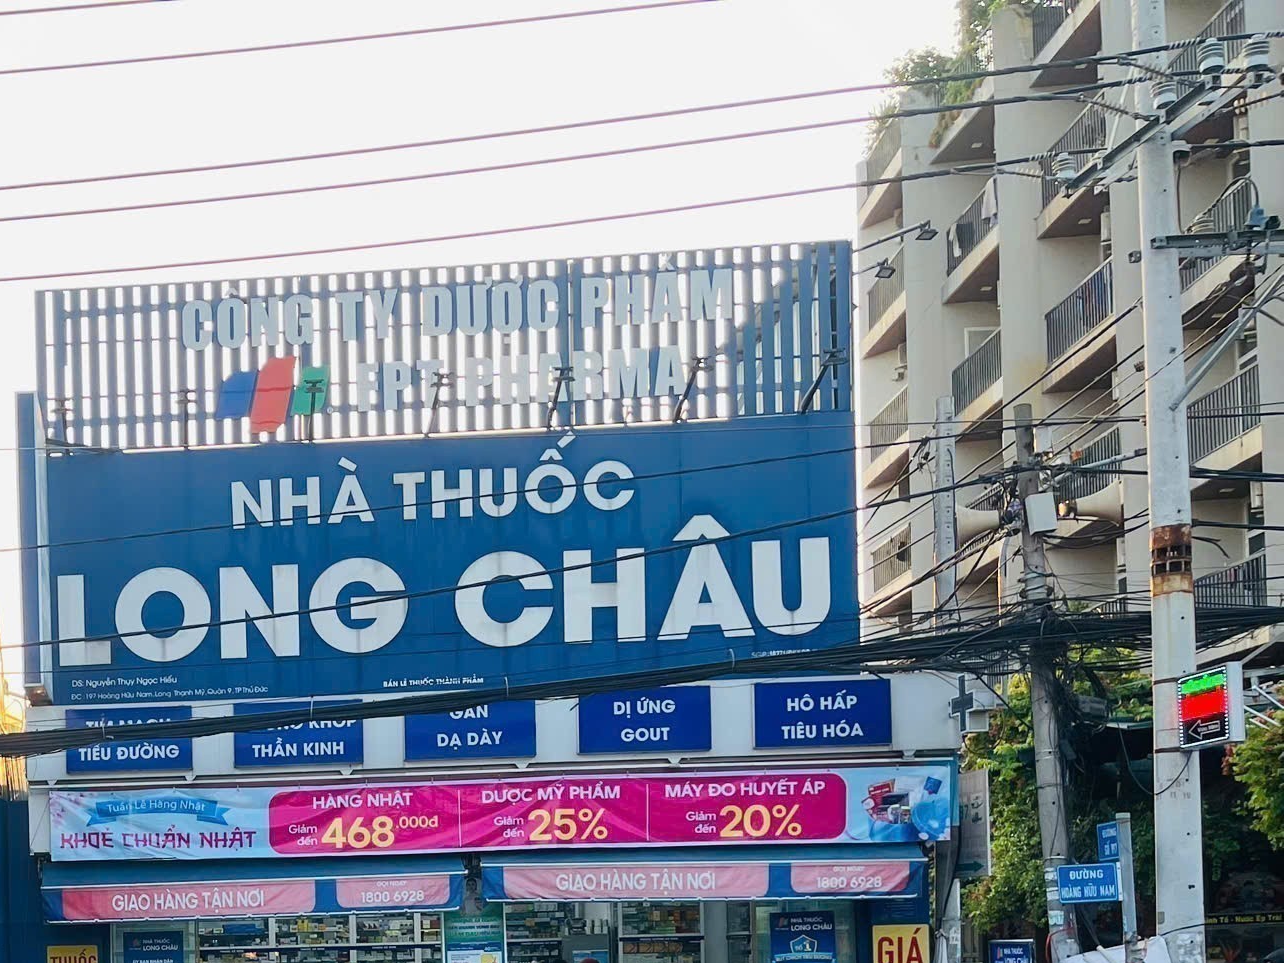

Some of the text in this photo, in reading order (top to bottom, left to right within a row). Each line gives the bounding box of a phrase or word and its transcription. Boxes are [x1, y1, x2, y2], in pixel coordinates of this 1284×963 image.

[182, 288, 314, 351] CÔNG
[335, 288, 398, 342] TY
[421, 276, 559, 344] DƯỢC
[357, 345, 684, 412] FPT PHARMA
[232, 433, 635, 530] NHÀ THUỐC
[57, 515, 832, 668] LONG CHÂU
[86, 677, 115, 688] Nguyễn
[136, 677, 157, 686] Ngọc
[383, 679, 398, 687] BÁN
[409, 677, 434, 686] THUỐC
[436, 676, 460, 685] THÀNH
[613, 696, 676, 719] DỊ ỨNG
[787, 690, 858, 712] HÔ HẤP
[437, 729, 503, 750] DẠ DÀY
[620, 727, 670, 742] GOUT
[782, 720, 864, 740] TIÊU HÓA
[116, 741, 180, 760] ĐƯỜNG
[252, 737, 345, 758] THẦN KINH
[481, 780, 621, 806] DƯỢC MỸ PHẨM
[664, 776, 826, 798] MÁY ĐO HUYẾT ÁP
[150, 799, 177, 811] Hàng
[180, 800, 206, 813] Nhật
[312, 790, 413, 810] HÀNG NHẬT
[288, 823, 318, 835] Giảm
[494, 808, 608, 841] Giảm 25%
[685, 803, 802, 837] Giảm 20%
[694, 821, 716, 834] đến
[122, 824, 190, 849] CHUẨN
[199, 827, 257, 851] NHẬT
[297, 834, 318, 846] đến
[503, 827, 524, 838] đến
[556, 868, 715, 894] GIAO HÀNG TẬN NƠI
[816, 876, 882, 889] 1800 6928
[1069, 868, 1104, 880] ĐƯỜNG
[112, 888, 264, 913] GIAO HÀNG TẬN NƠI
[361, 890, 425, 903] 1800 6928
[1060, 884, 1081, 899] HOÀNG
[1100, 884, 1116, 896] NAM
